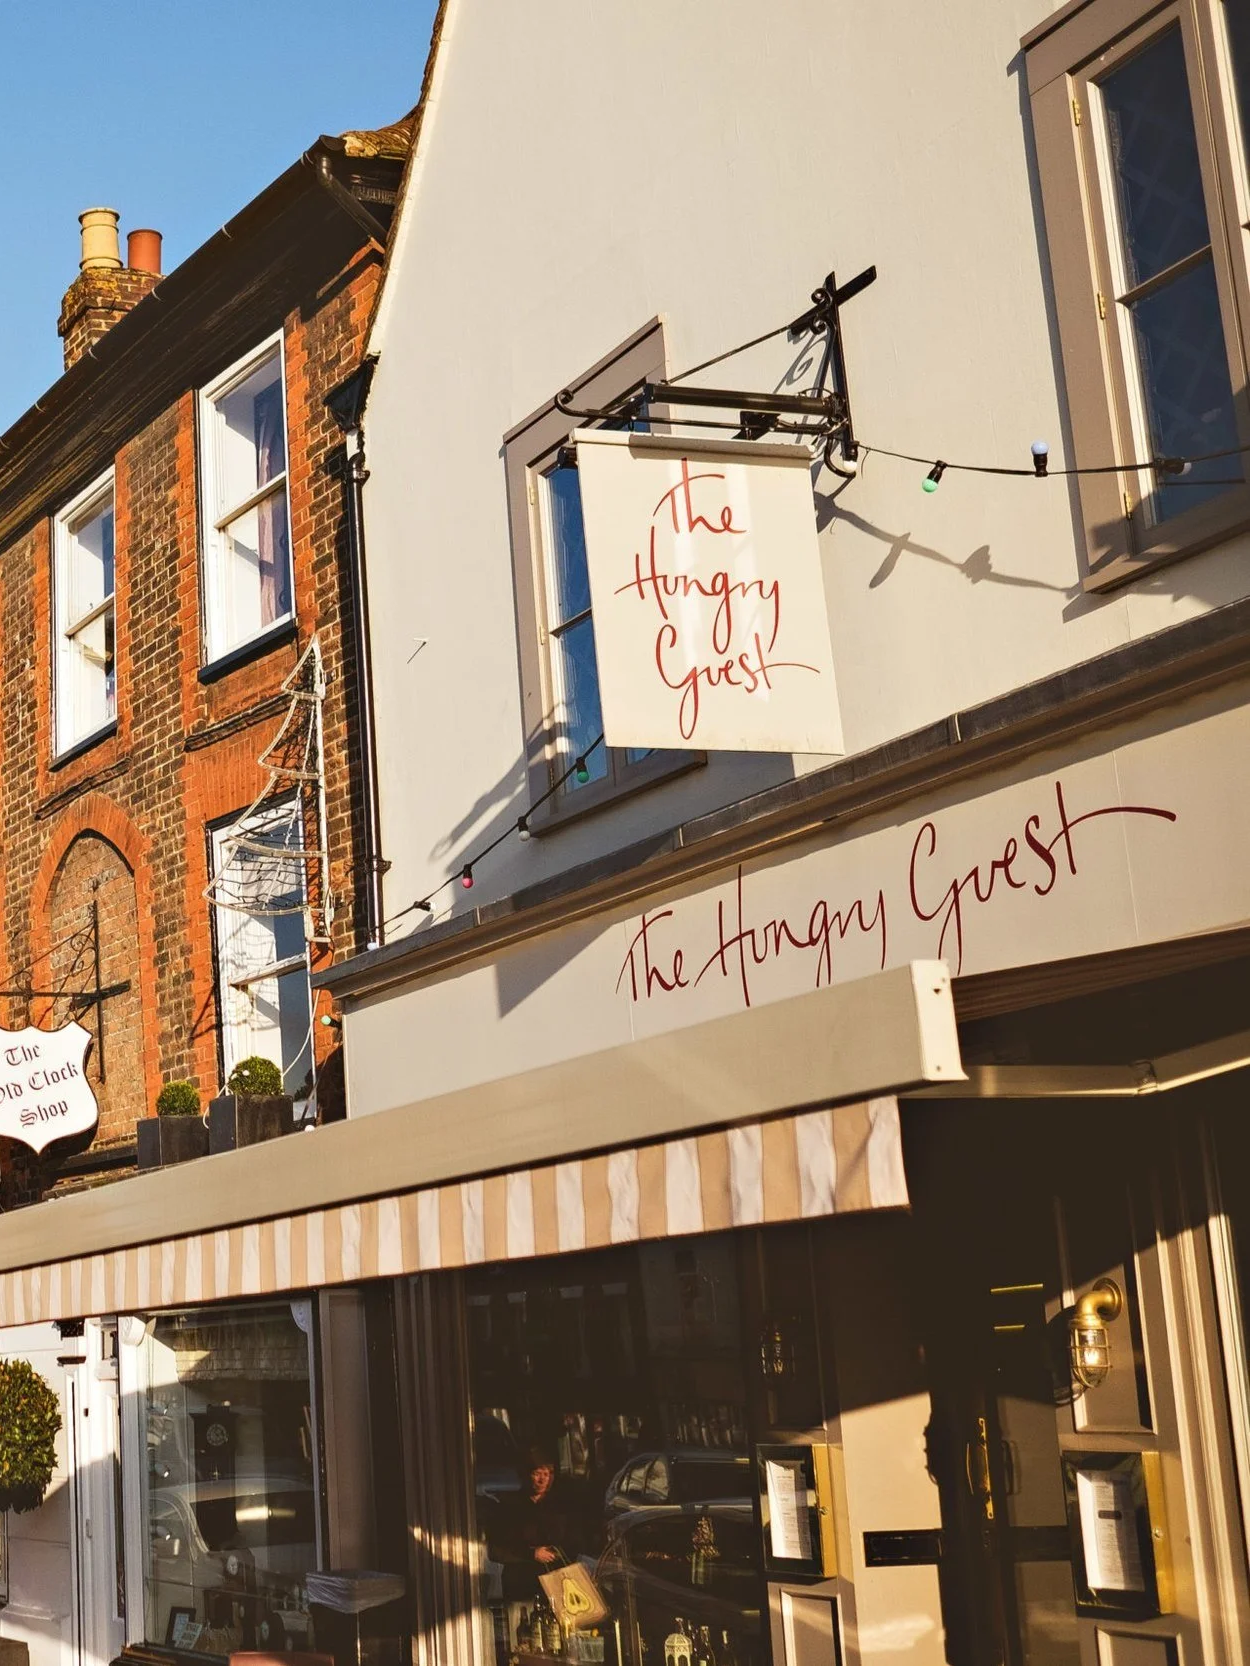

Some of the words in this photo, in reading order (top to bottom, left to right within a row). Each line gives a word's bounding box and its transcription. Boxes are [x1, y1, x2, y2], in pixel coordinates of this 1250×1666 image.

[653, 457, 747, 534] The
[614, 526, 780, 655] Hungry
[656, 624, 821, 740] Guest
[616, 909, 690, 1002] The
[694, 864, 887, 1007] Hungry
[909, 780, 1177, 976] Guest
[4, 1045, 41, 1066] The
[28, 1061, 79, 1090] Clock
[19, 1100, 69, 1129] Shop
